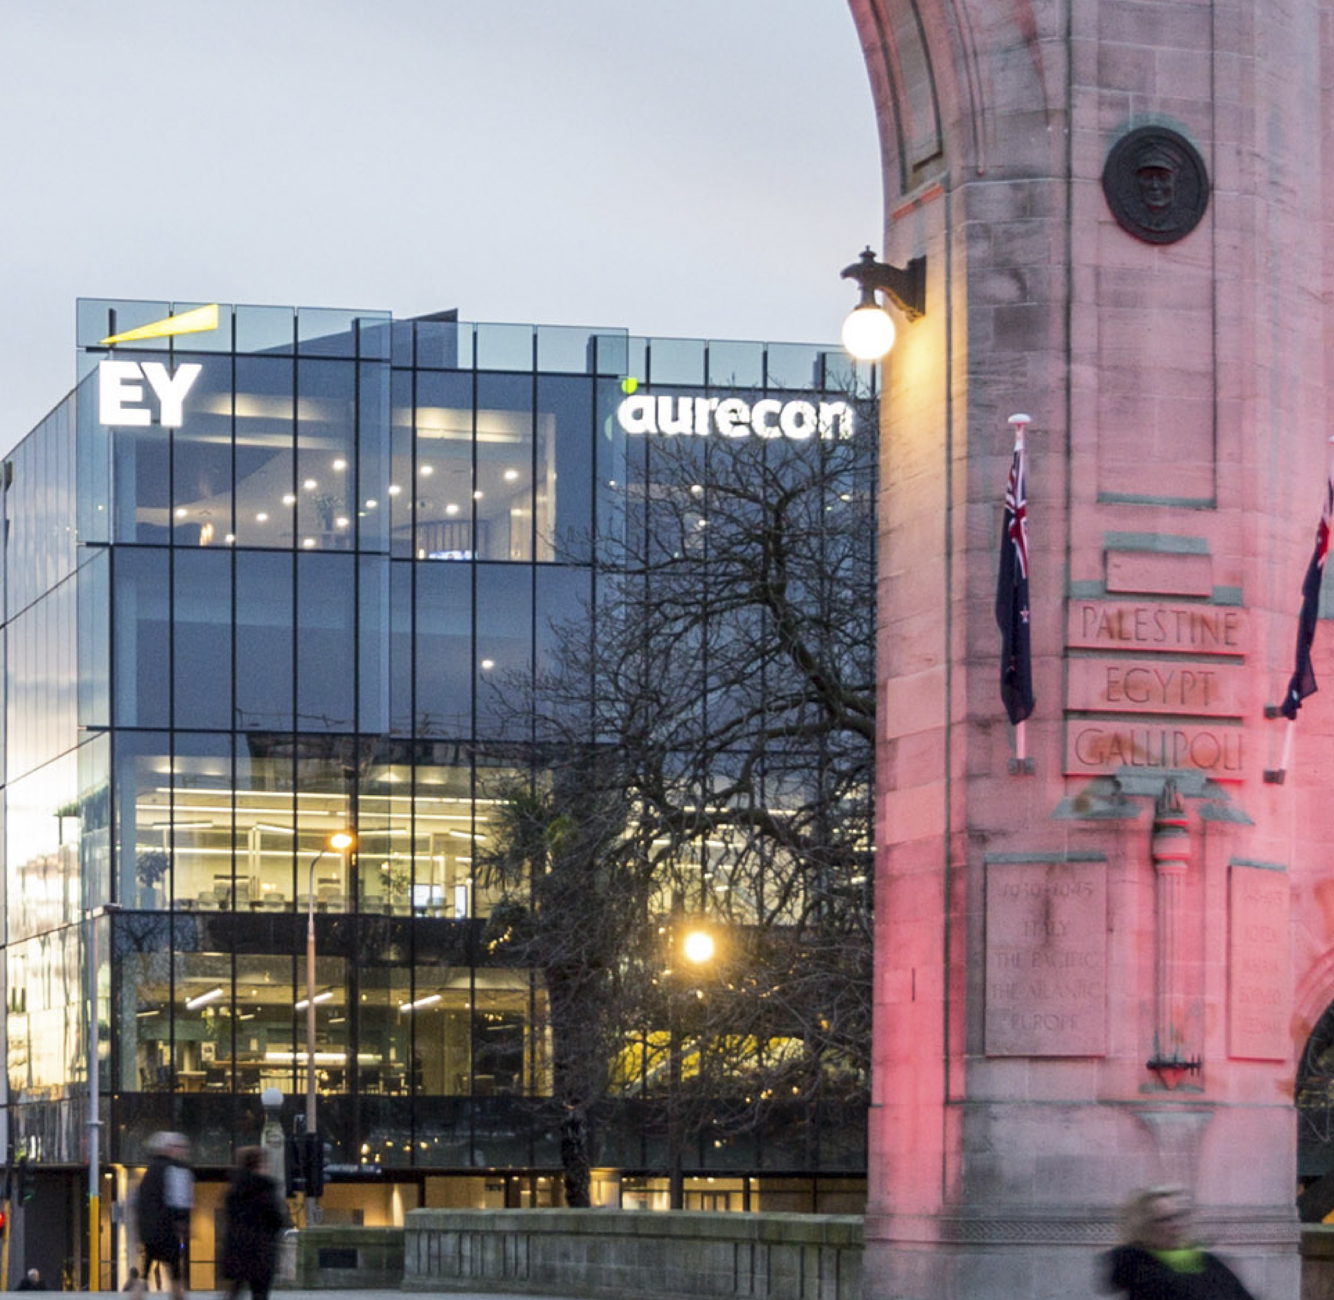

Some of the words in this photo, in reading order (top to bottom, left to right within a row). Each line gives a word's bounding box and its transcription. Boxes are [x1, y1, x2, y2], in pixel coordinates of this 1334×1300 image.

[99, 360, 203, 428] EY
[617, 394, 855, 440] aurecon
[1082, 605, 1238, 646] PALESTINE
[1106, 666, 1216, 707] EGYPT
[1074, 727, 1243, 772] GALLIPOLI
